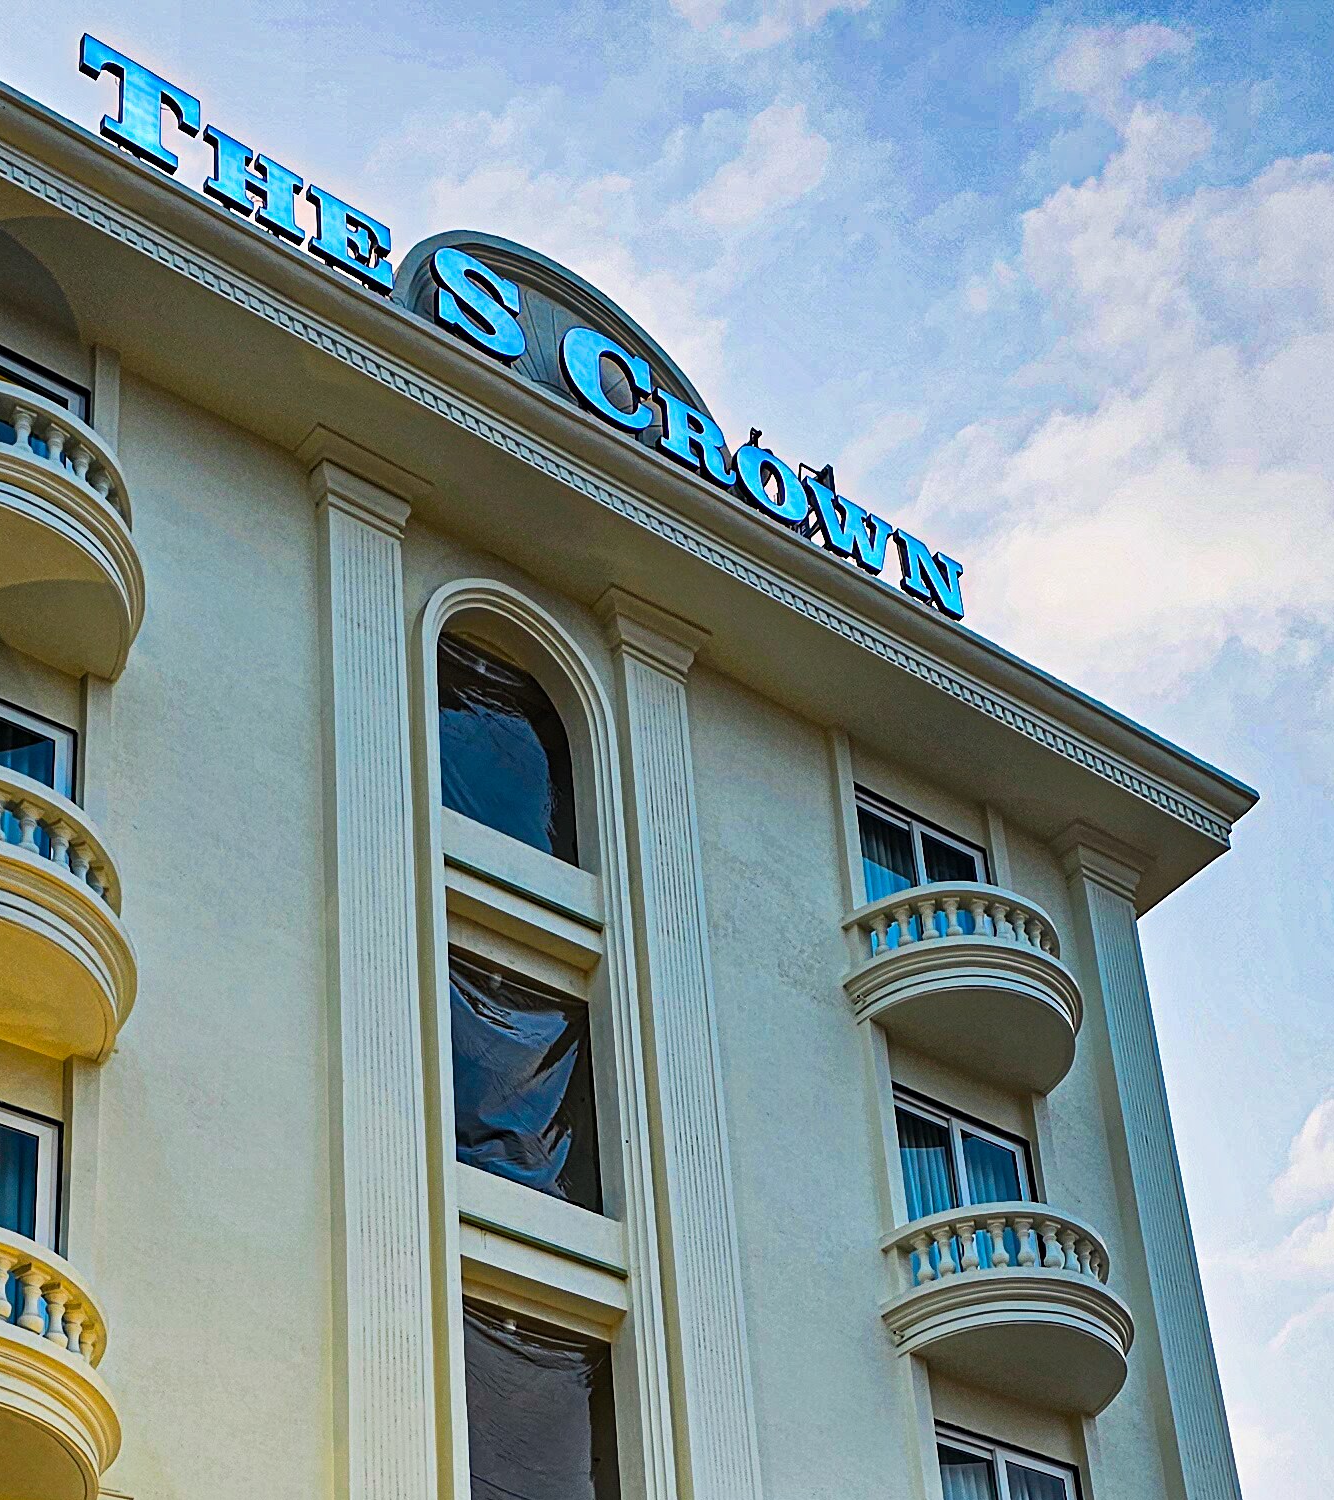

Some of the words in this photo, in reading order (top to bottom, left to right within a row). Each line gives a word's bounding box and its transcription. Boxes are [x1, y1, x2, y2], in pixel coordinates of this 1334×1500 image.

[78, 32, 395, 295] THE
[430, 246, 527, 364] S
[559, 326, 965, 621] CROWN
